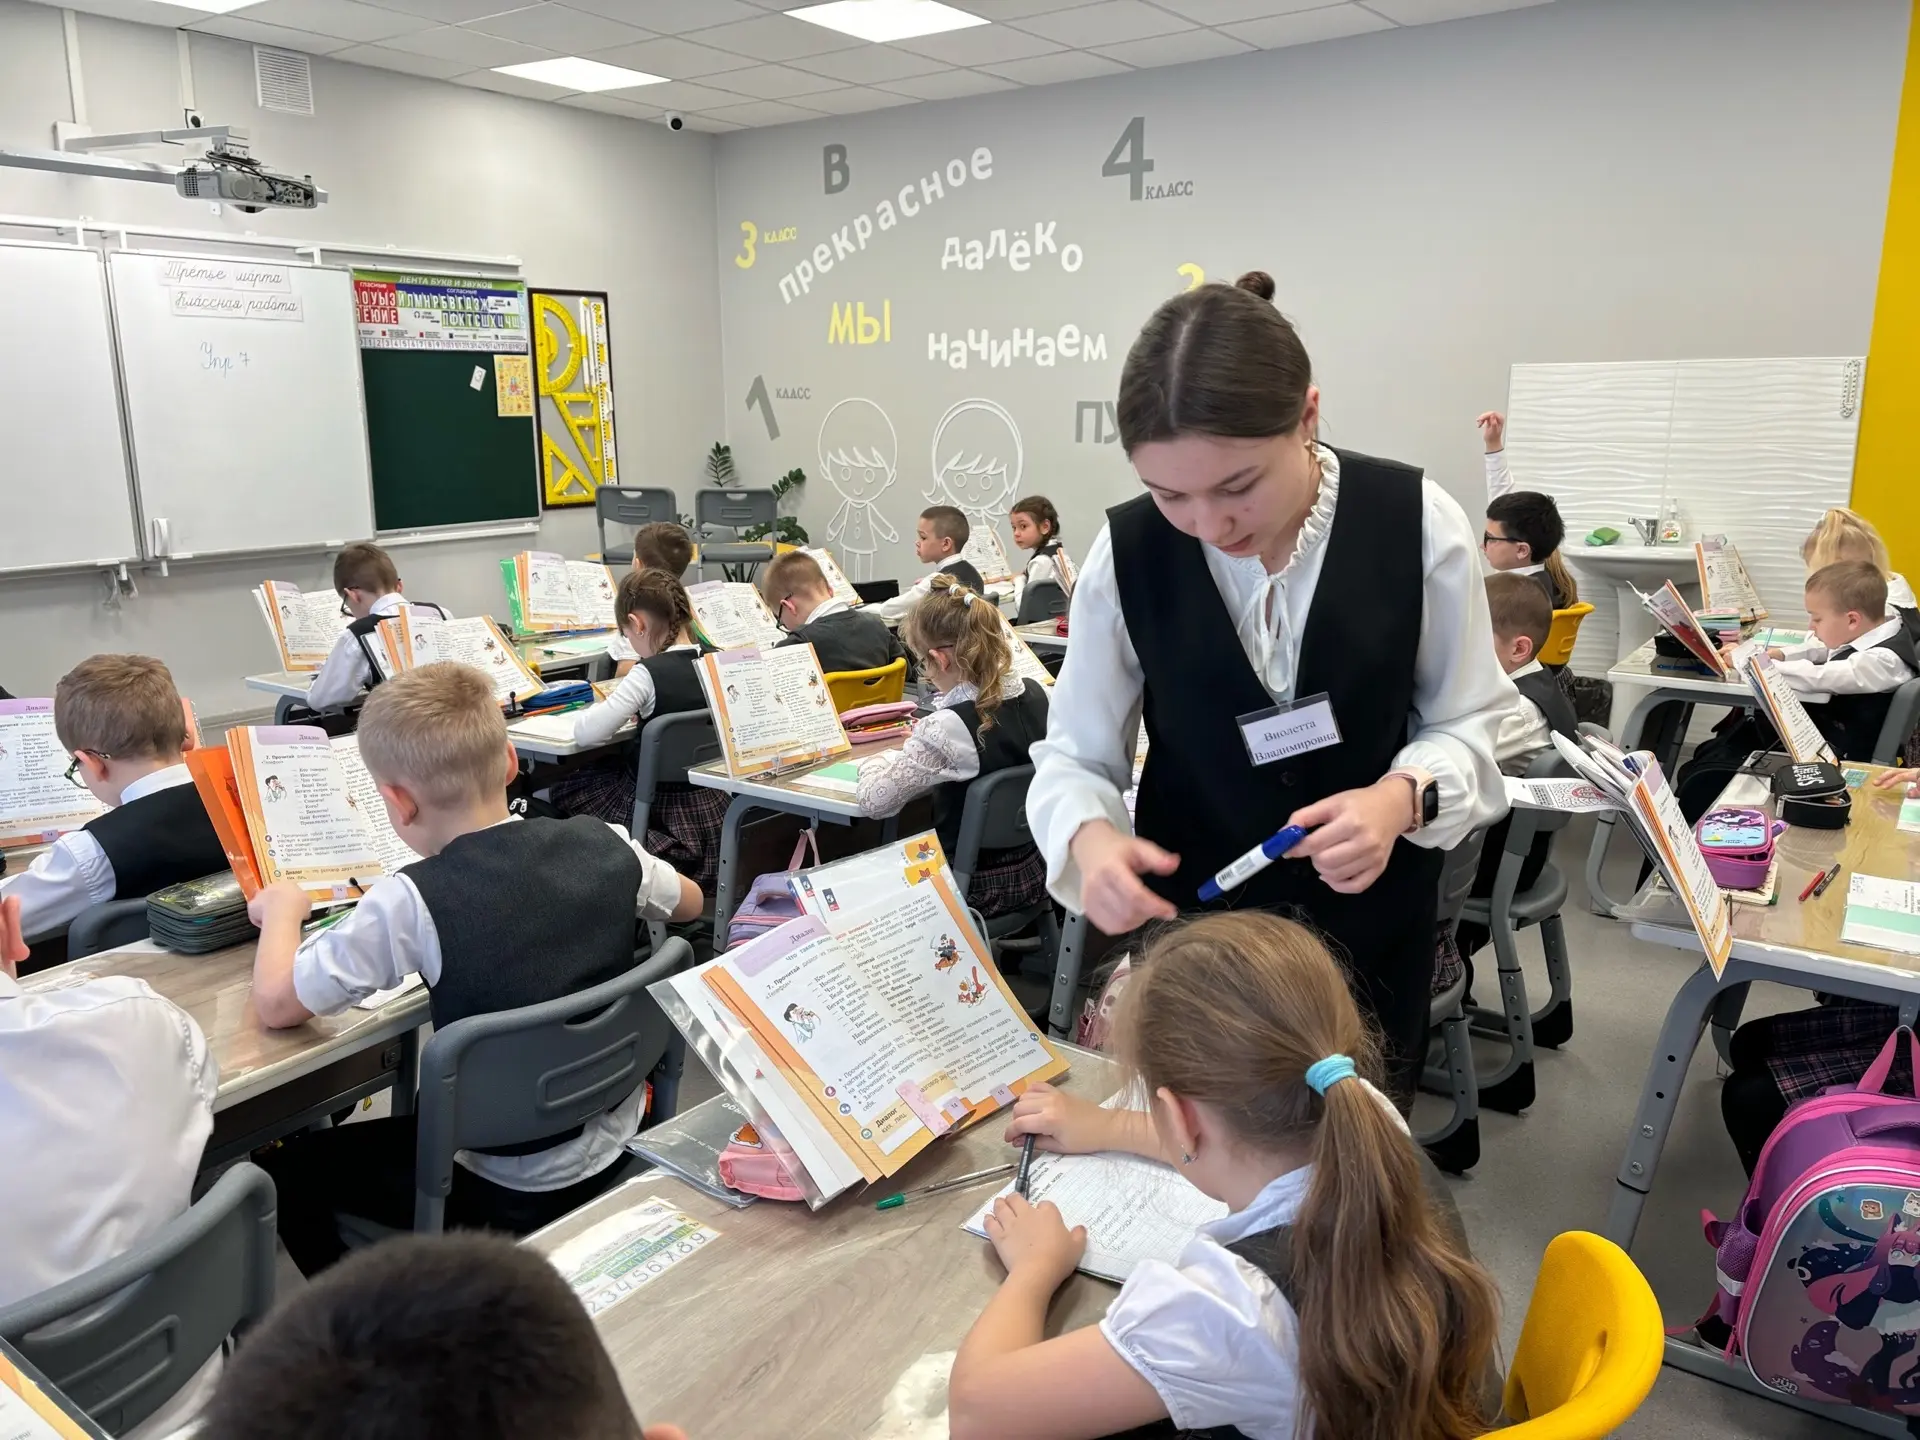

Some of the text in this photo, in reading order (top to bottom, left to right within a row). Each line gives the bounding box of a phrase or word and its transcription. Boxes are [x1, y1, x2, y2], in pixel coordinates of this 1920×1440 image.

[824, 144, 850, 194] В
[1102, 116, 1154, 200] 4
[736, 221, 758, 268] 3
[778, 147, 992, 304] прекрасное
[942, 222, 1083, 272] далёко
[400, 276, 428, 284] ЛЕНТА
[240, 352, 250, 366] 7
[928, 324, 1108, 369] начинаем
[746, 374, 780, 440] 1
[1254, 732, 1337, 762] Владимировна
[1264, 720, 1316, 742] Виолетта
[997, 1088, 1004, 1096] 15
[875, 1108, 898, 1127] Диалог
